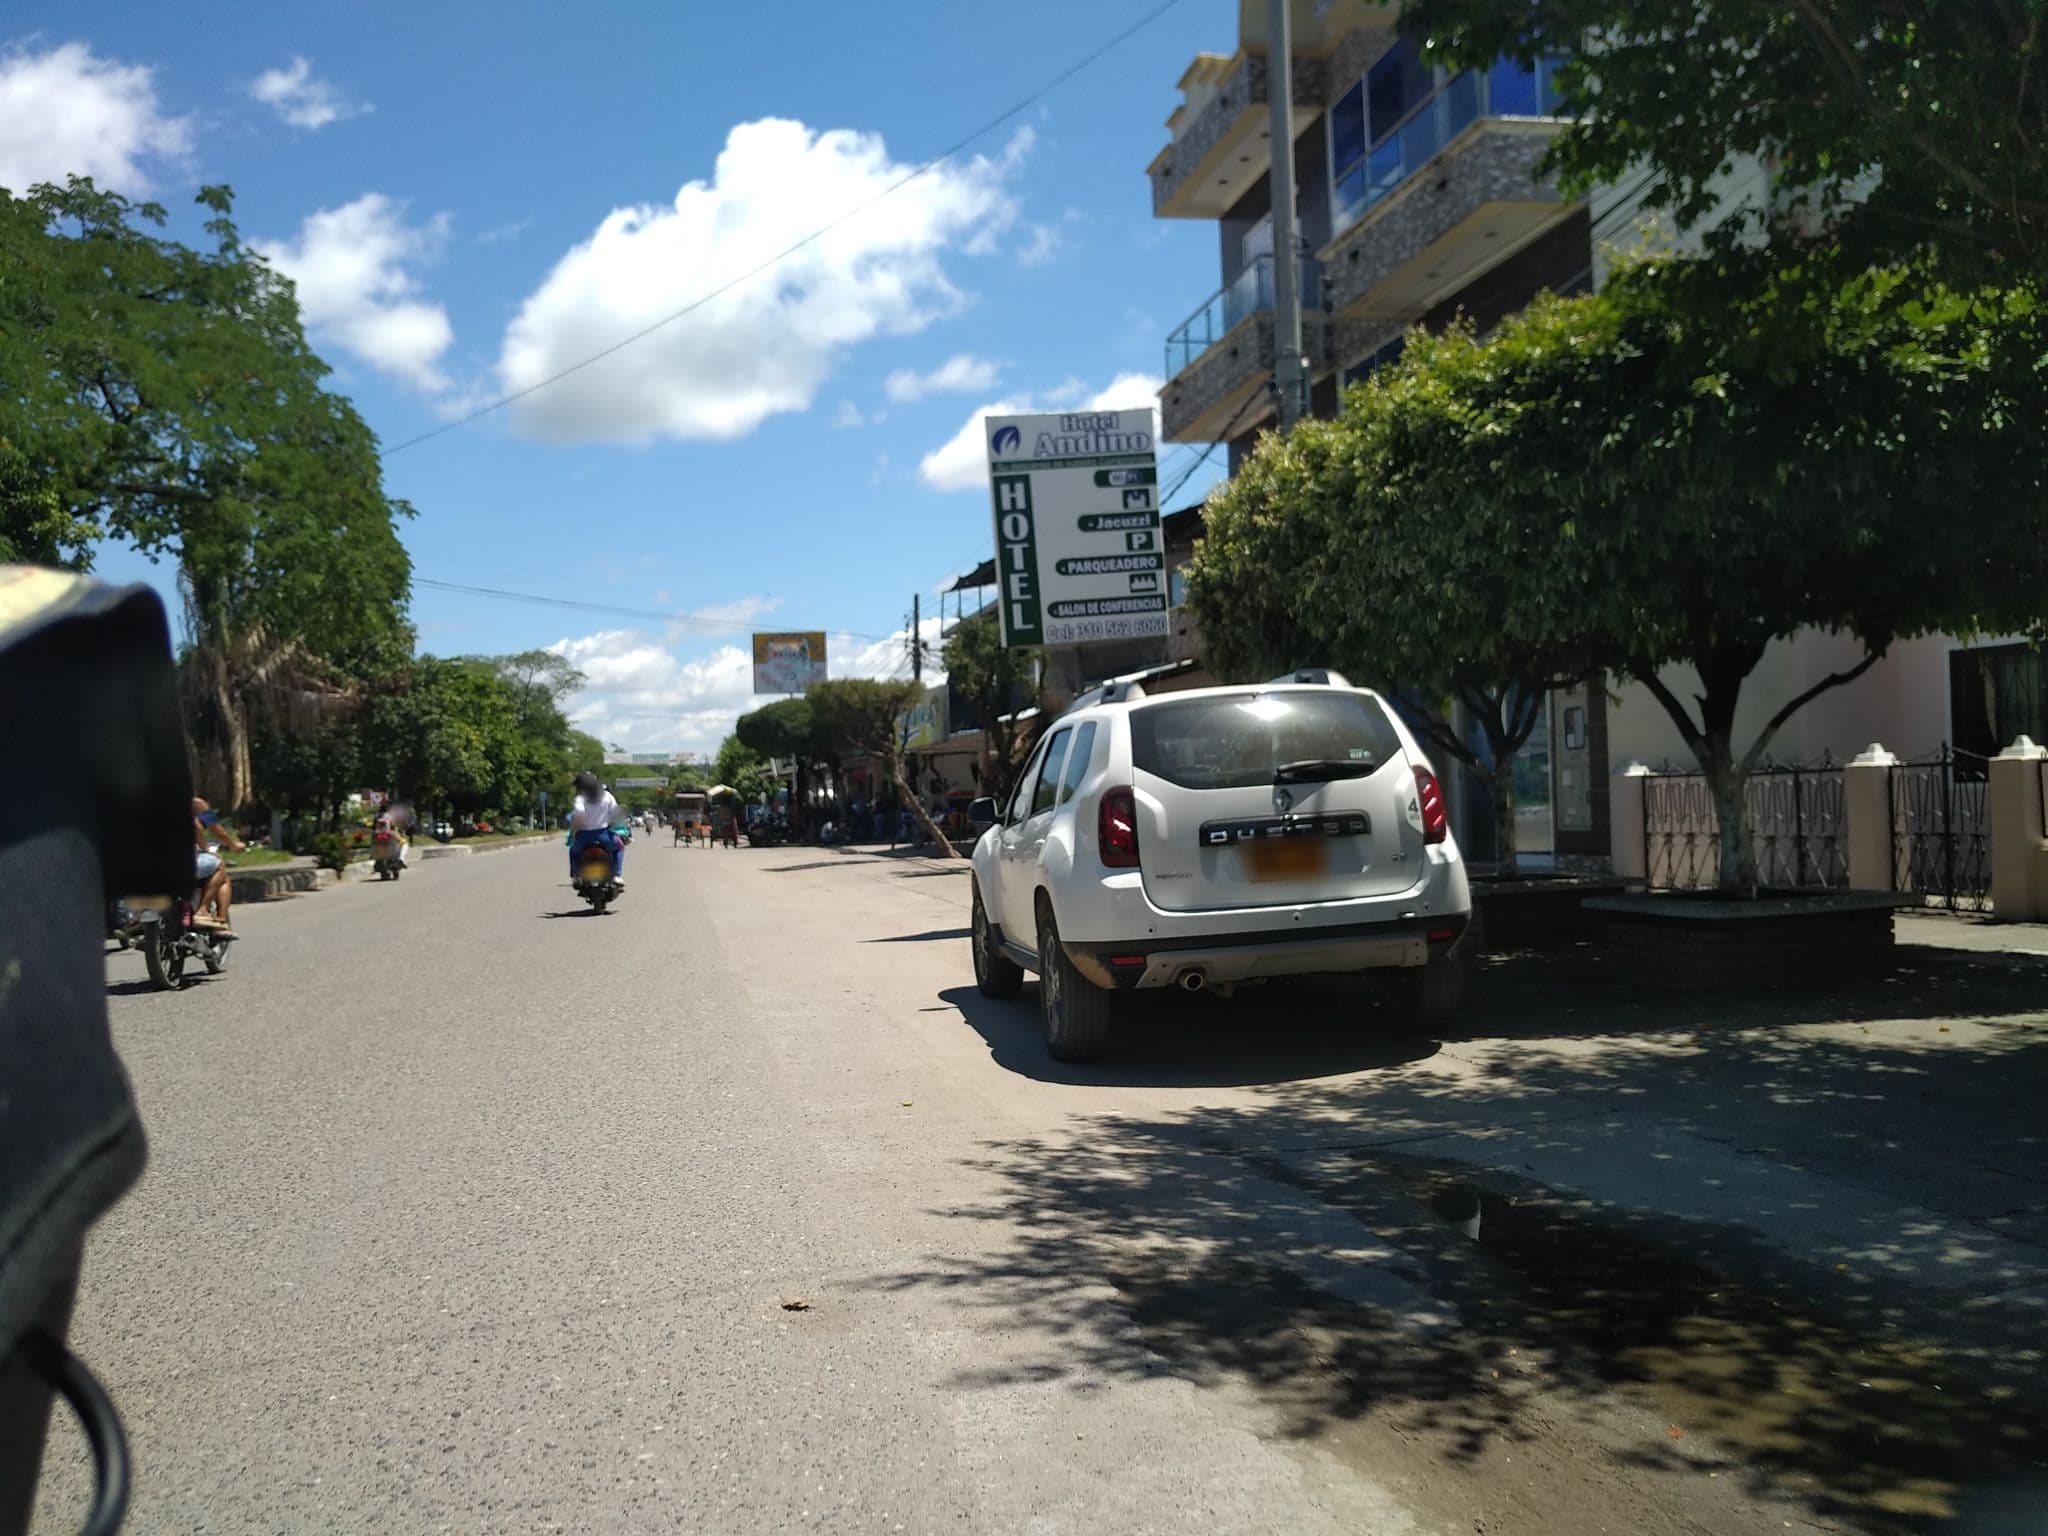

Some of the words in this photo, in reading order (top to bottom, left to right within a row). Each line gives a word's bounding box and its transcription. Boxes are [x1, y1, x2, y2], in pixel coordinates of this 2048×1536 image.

[1061, 412, 1120, 432] Hotel
[1033, 432, 1151, 458] Andino
[1096, 514, 1151, 529] Jacuzzi
[1131, 533, 1147, 550] P
[1001, 482, 1034, 630] HOTEL
[1067, 556, 1157, 574] PARQUEADERO
[1057, 602, 1086, 617] SALON
[1087, 602, 1099, 615] DE
[1100, 597, 1162, 613] CONFERENCIAS
[1408, 797, 1419, 813] 4
